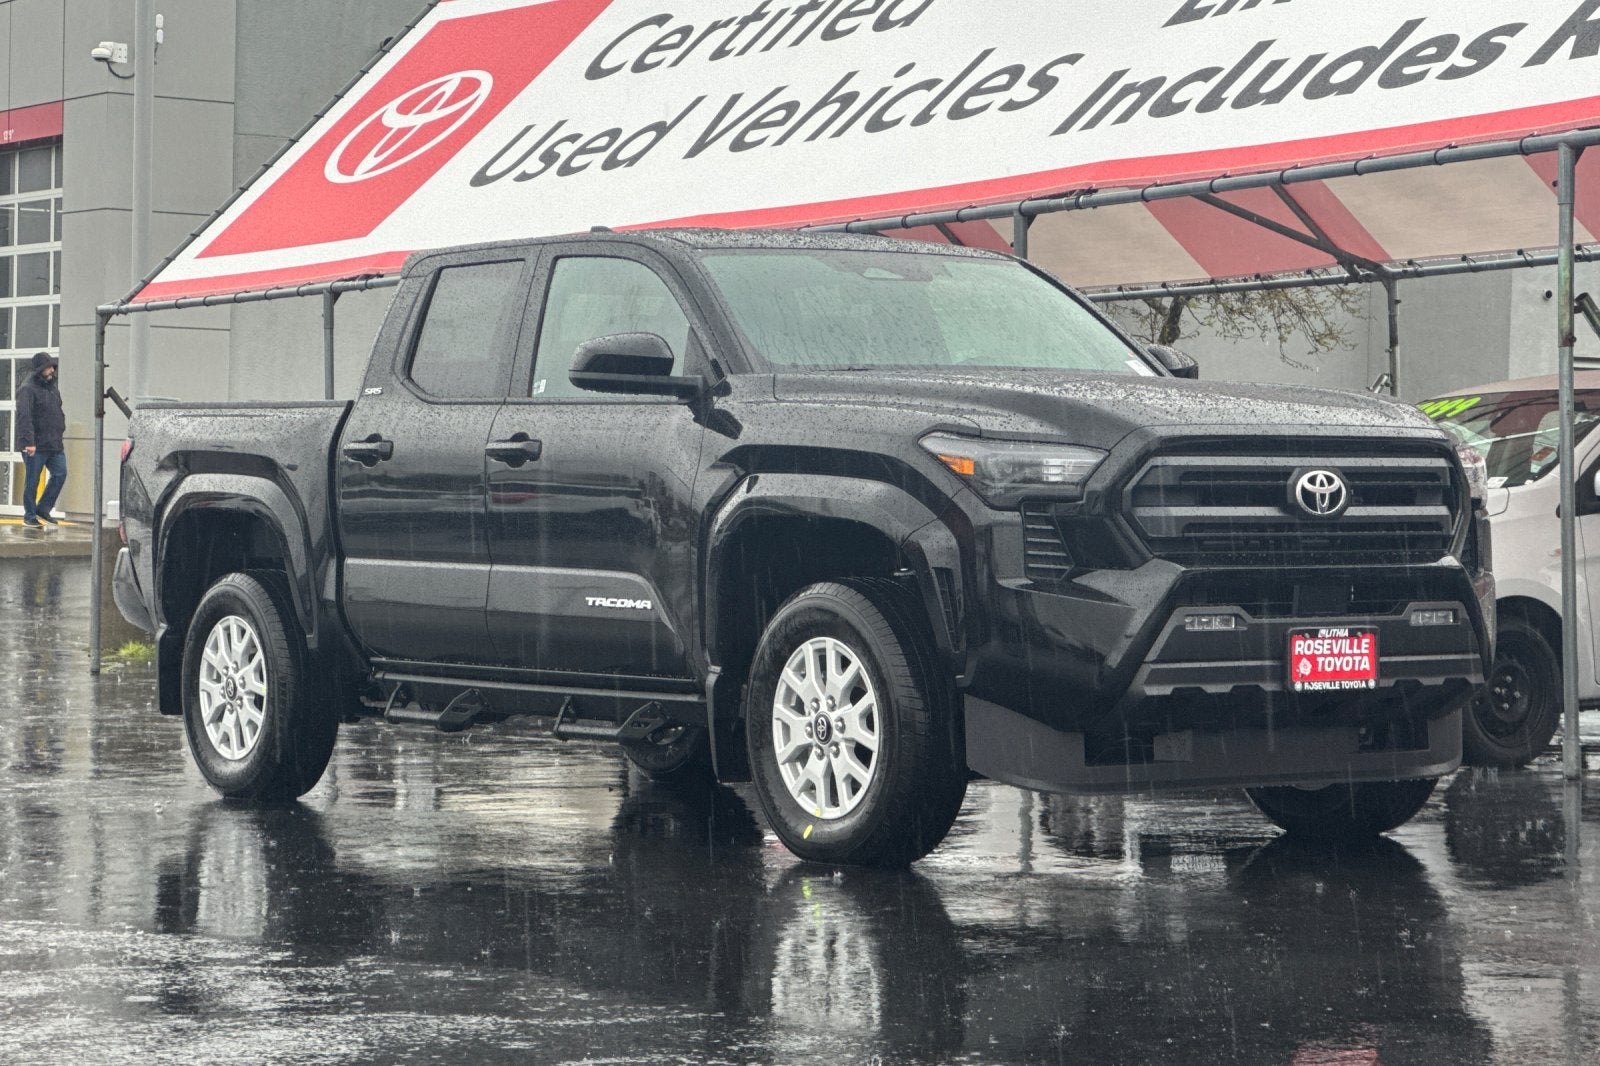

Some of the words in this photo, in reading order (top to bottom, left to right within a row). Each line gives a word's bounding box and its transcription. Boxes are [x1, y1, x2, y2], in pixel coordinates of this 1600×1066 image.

[584, 0, 936, 81] Certified
[1049, 18, 1529, 137] Includes
[469, 94, 708, 188] Used
[682, 48, 1085, 160] Vehicles
[585, 596, 652, 610] TACOMA
[1326, 628, 1349, 638] LITHIA
[1295, 638, 1370, 655] ROSEVILLE
[1317, 656, 1371, 672] TOYOTA
[1304, 681, 1340, 690] ROSEVILLE
[1341, 680, 1367, 689] TOYOTA
